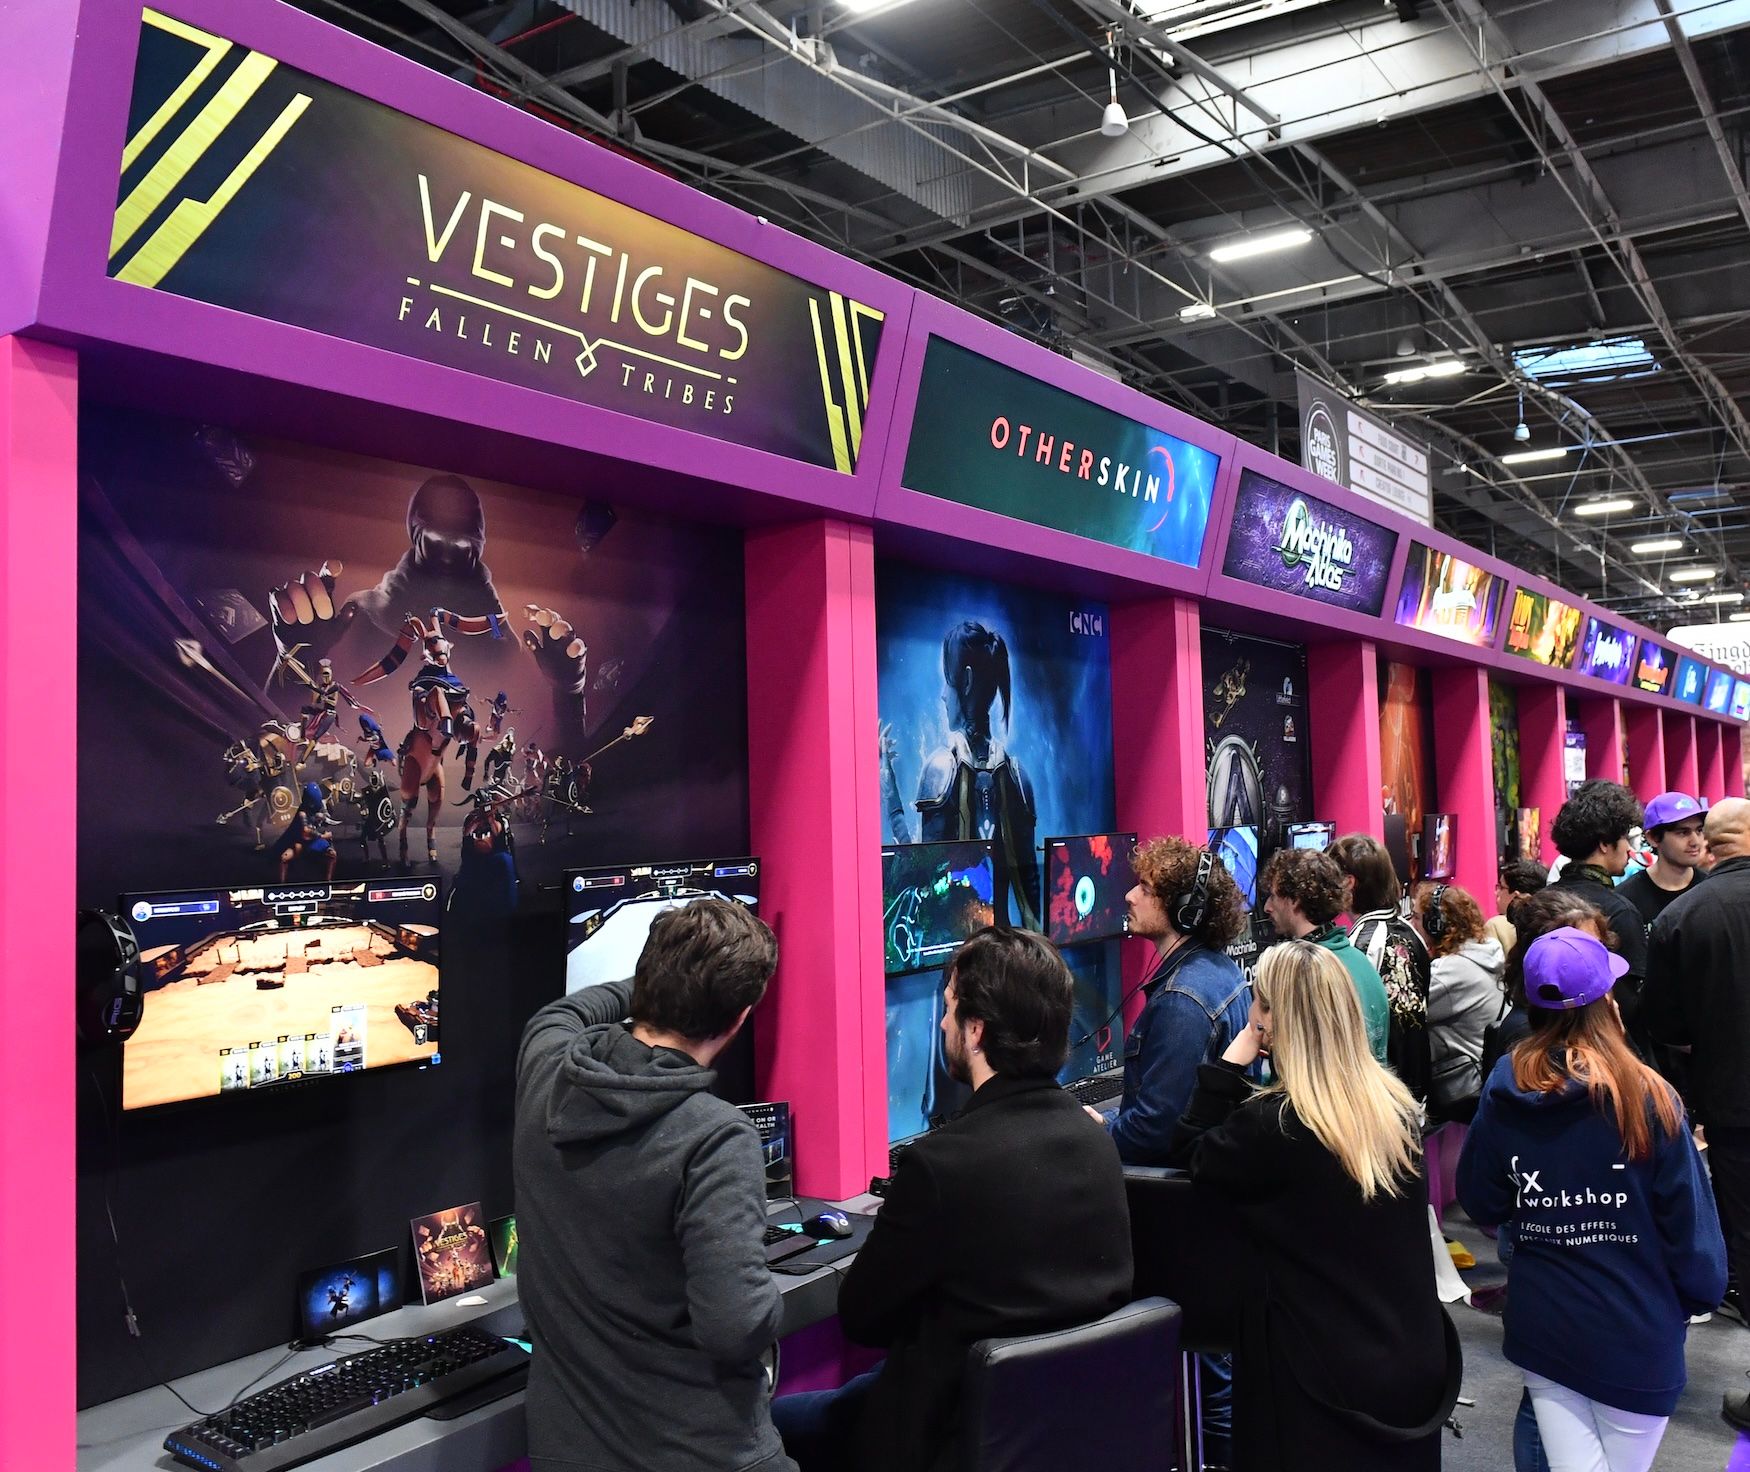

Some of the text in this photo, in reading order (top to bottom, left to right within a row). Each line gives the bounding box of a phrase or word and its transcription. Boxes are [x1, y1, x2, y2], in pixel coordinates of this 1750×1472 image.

[417, 173, 752, 361] VESTIGES
[397, 296, 735, 415] FALLEN TRIBES
[990, 416, 1161, 504] OTHERSKIN
[1309, 438, 1337, 467] GAMES
[1314, 457, 1337, 483] WEEK
[1096, 1051, 1113, 1064] GAME
[1524, 1187, 1628, 1209] workshop
[1555, 1224, 1576, 1234] DES
[1580, 1221, 1617, 1231] EFFETS
